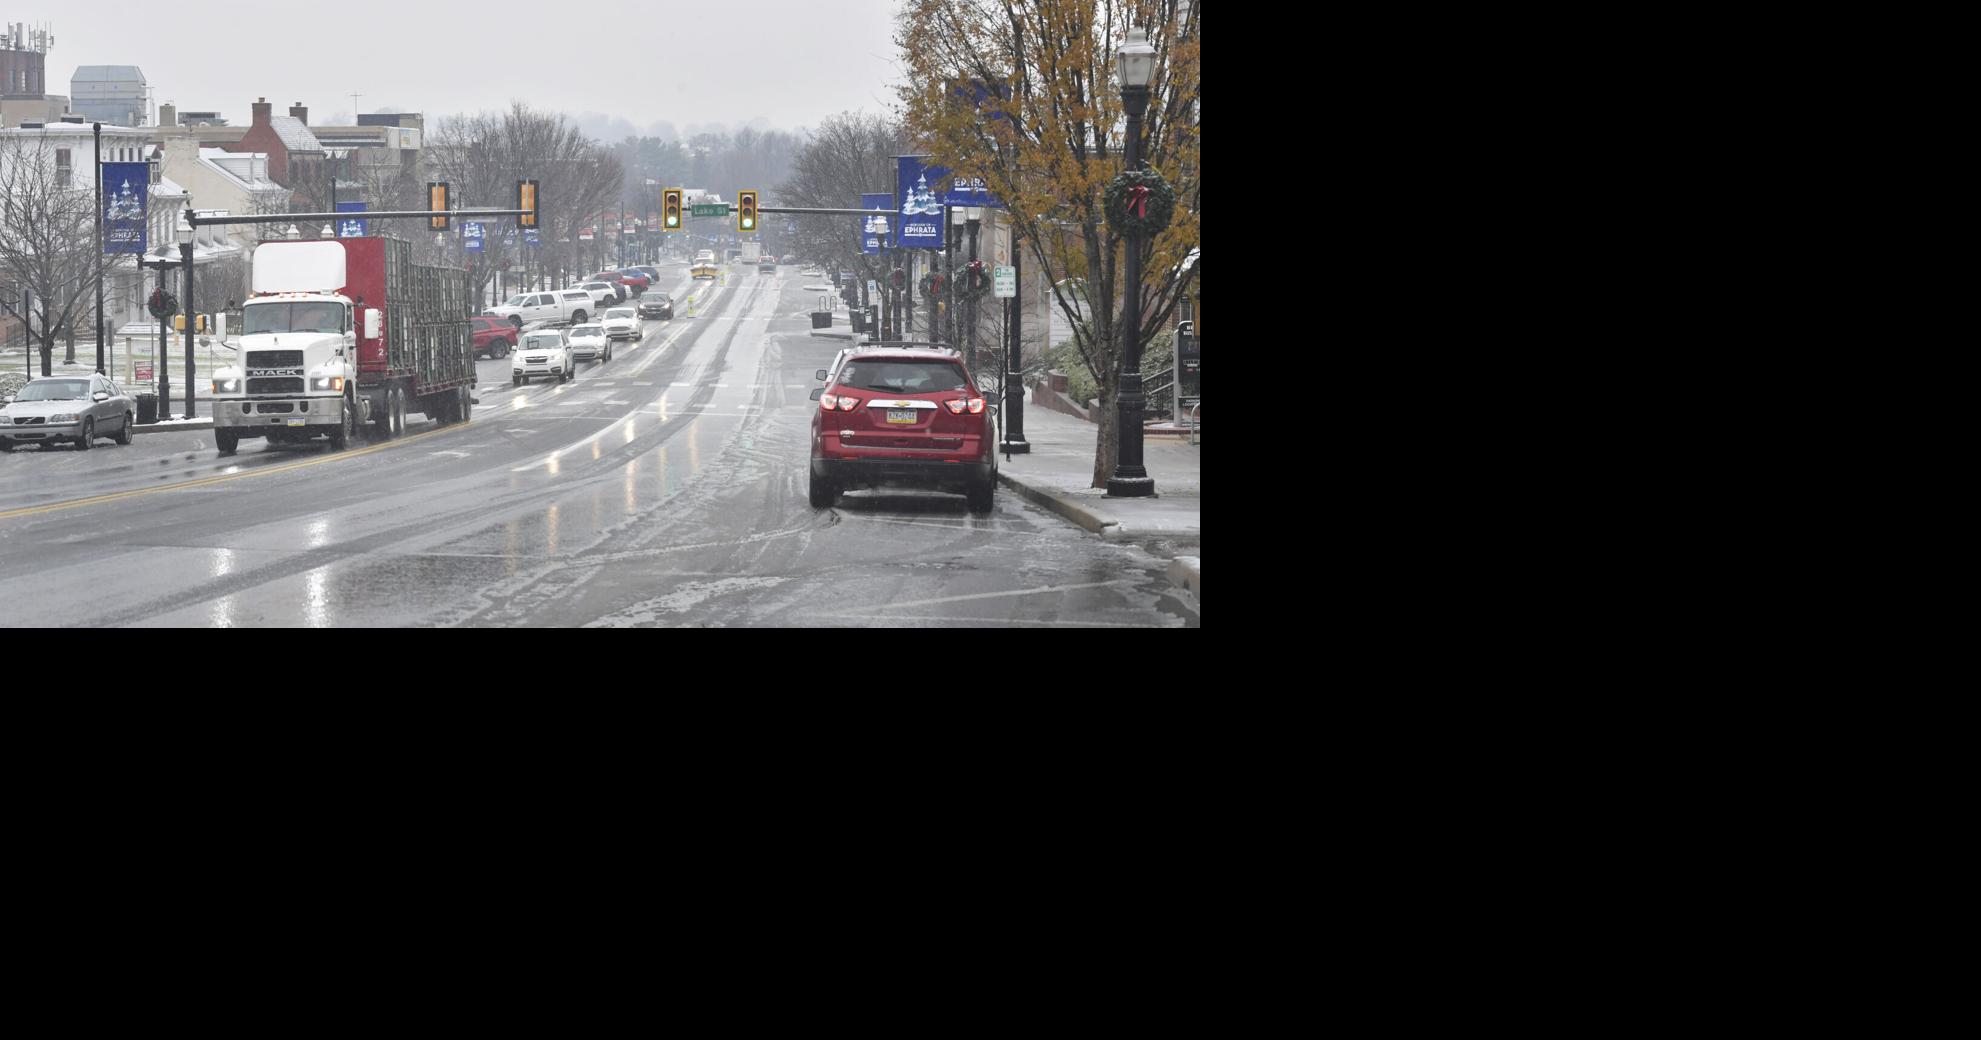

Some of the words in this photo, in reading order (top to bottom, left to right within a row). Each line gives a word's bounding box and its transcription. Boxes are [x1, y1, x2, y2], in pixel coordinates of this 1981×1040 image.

[694, 207, 714, 215] Lake
[717, 207, 726, 215] St
[904, 226, 937, 234] EPHRATA
